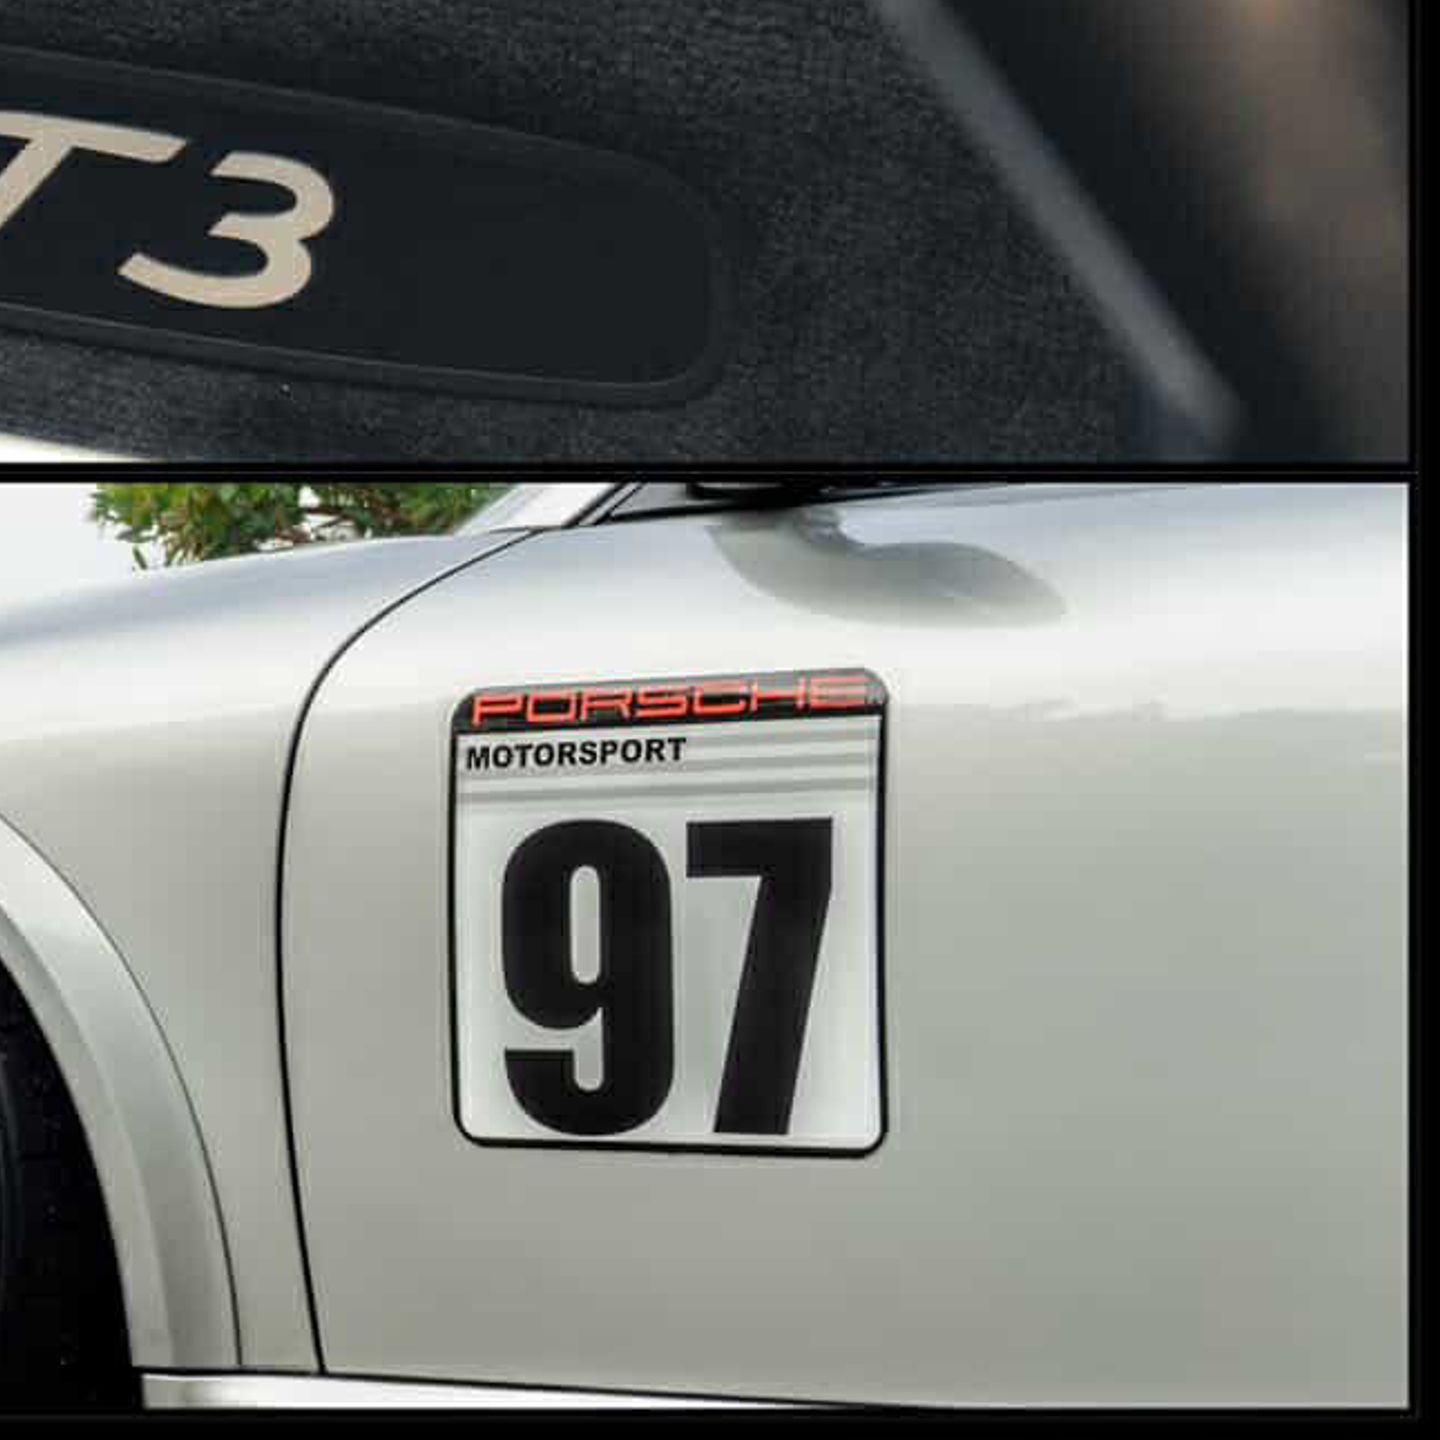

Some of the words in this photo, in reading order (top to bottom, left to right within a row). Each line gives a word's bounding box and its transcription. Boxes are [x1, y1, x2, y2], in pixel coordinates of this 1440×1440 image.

[471, 674, 876, 727] PORSCHE
[465, 736, 688, 770] MOTORSPORT
[502, 818, 833, 1136] 97
